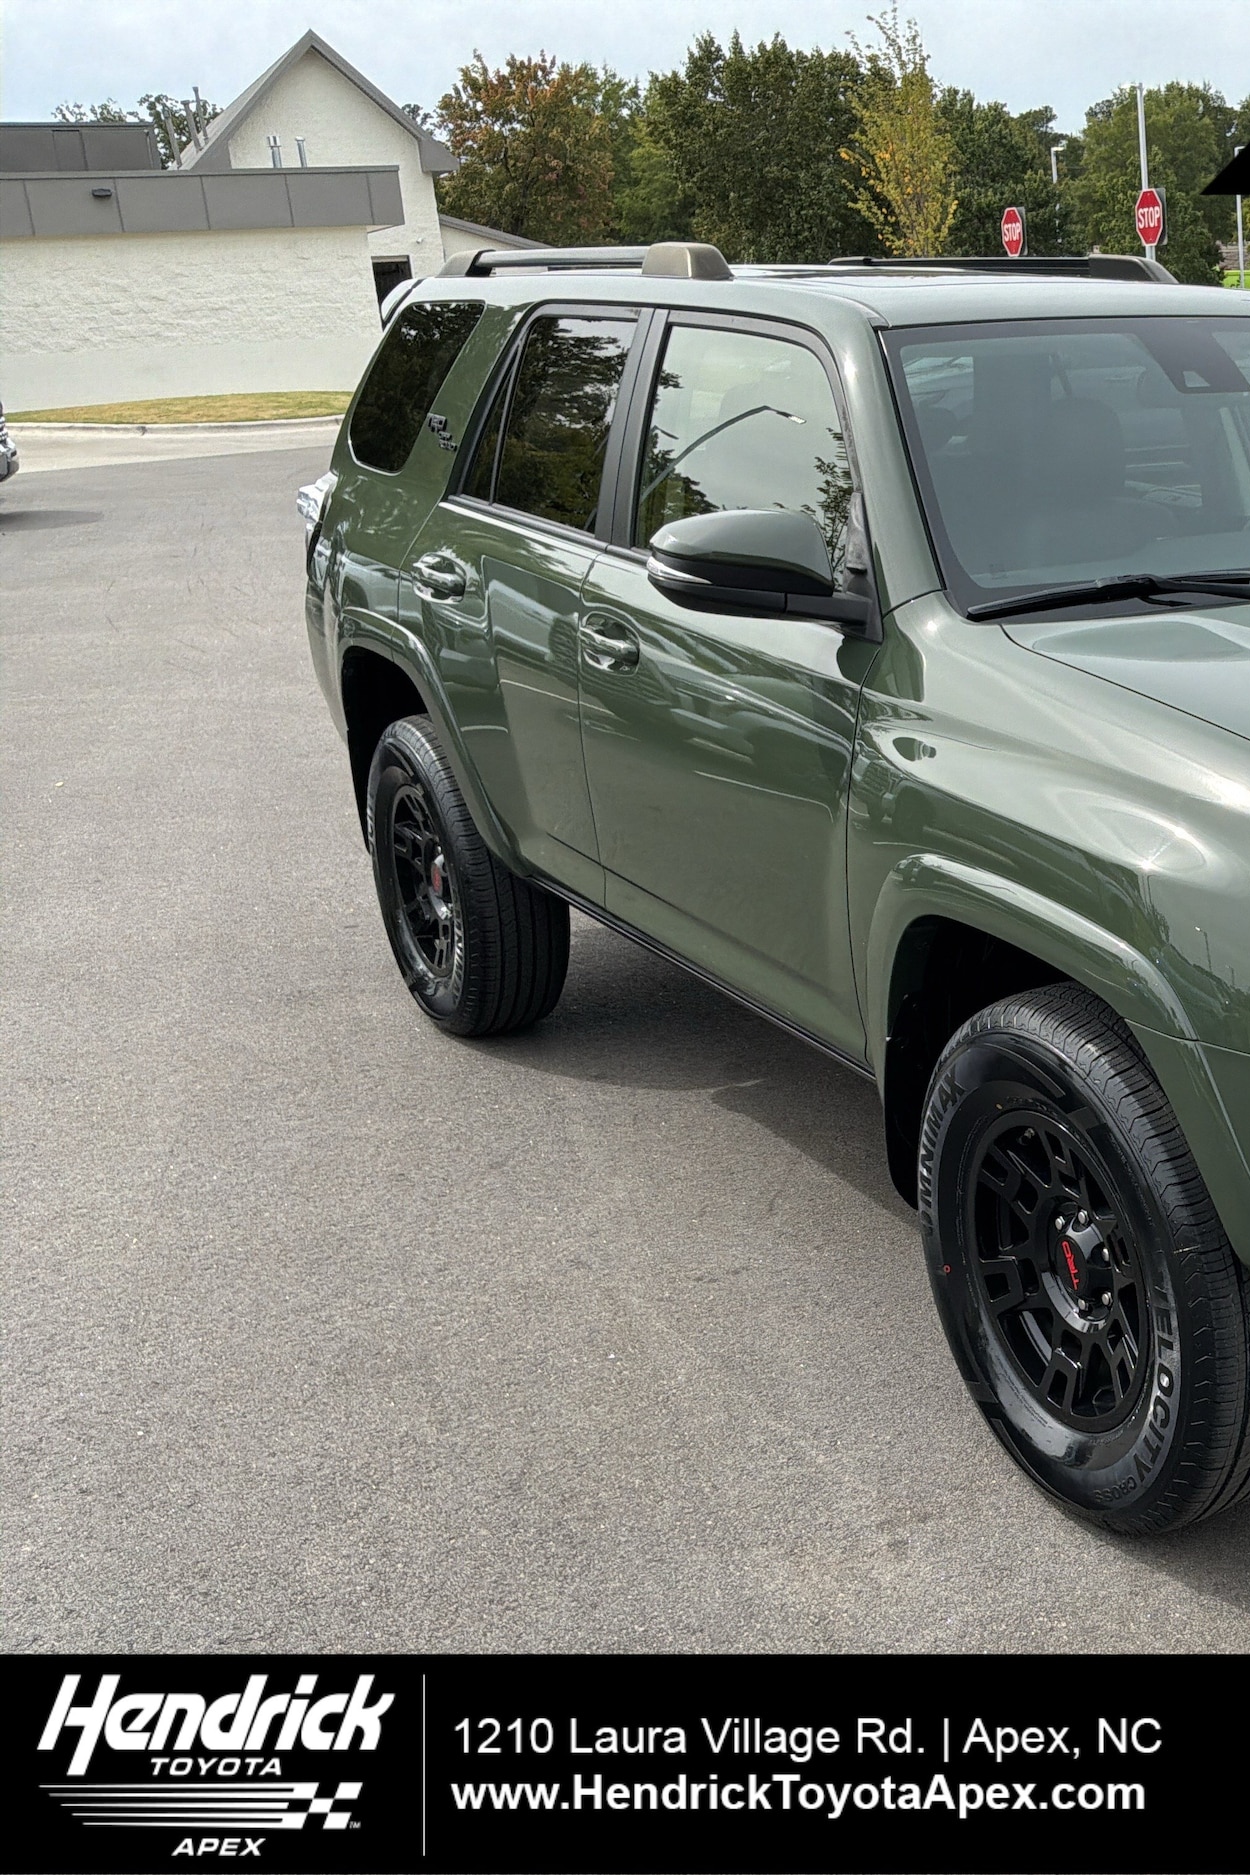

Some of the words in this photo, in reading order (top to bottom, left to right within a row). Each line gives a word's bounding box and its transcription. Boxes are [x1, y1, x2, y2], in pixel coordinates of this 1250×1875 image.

[1003, 221, 1021, 242] STOP
[1138, 206, 1160, 229] STOP
[1061, 1240, 1080, 1290] TRD
[1133, 1268, 1176, 1484] VELOCITY
